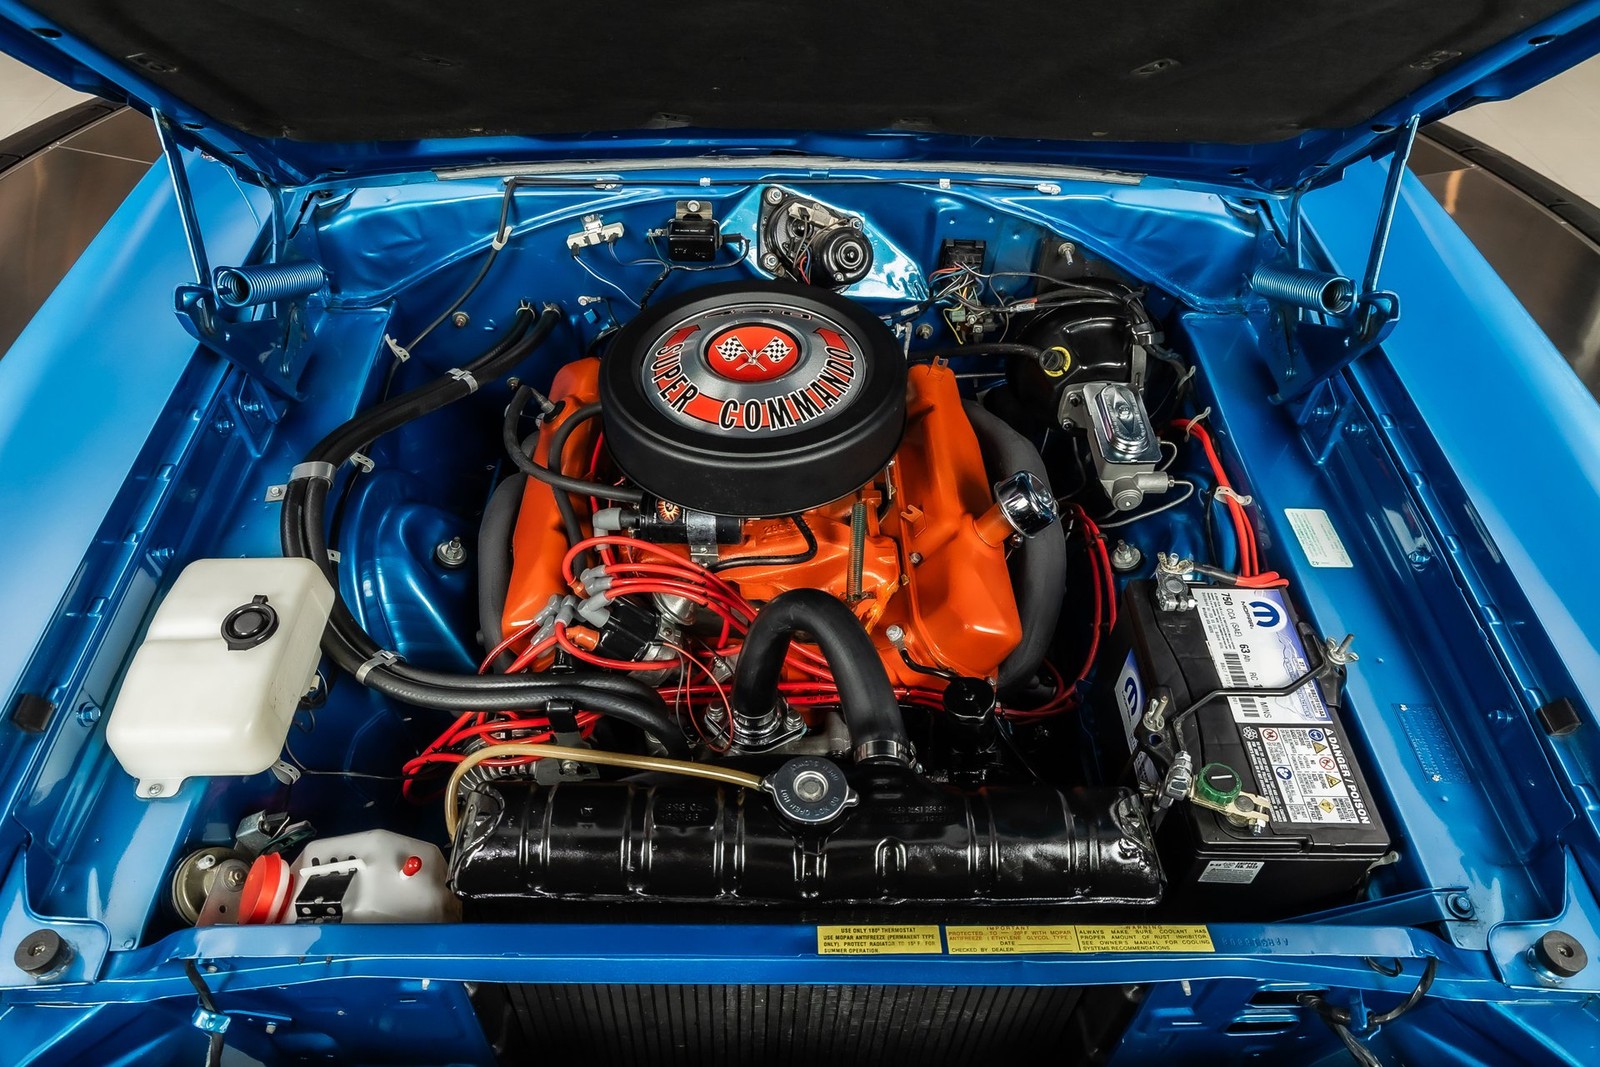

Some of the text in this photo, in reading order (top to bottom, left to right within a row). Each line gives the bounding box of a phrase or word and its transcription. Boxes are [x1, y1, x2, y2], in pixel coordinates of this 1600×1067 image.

[650, 342, 856, 432] SUPER COMMANDO
[1221, 593, 1233, 605] 750
[1227, 609, 1236, 620] CCA
[1240, 601, 1254, 628] MOPAR
[1230, 623, 1242, 637] (SAE)
[1240, 644, 1250, 653] 63
[1250, 673, 1258, 681] RC
[1260, 702, 1272, 718] MINS
[1328, 736, 1351, 777] DANGER
[1347, 785, 1371, 823] POISON
